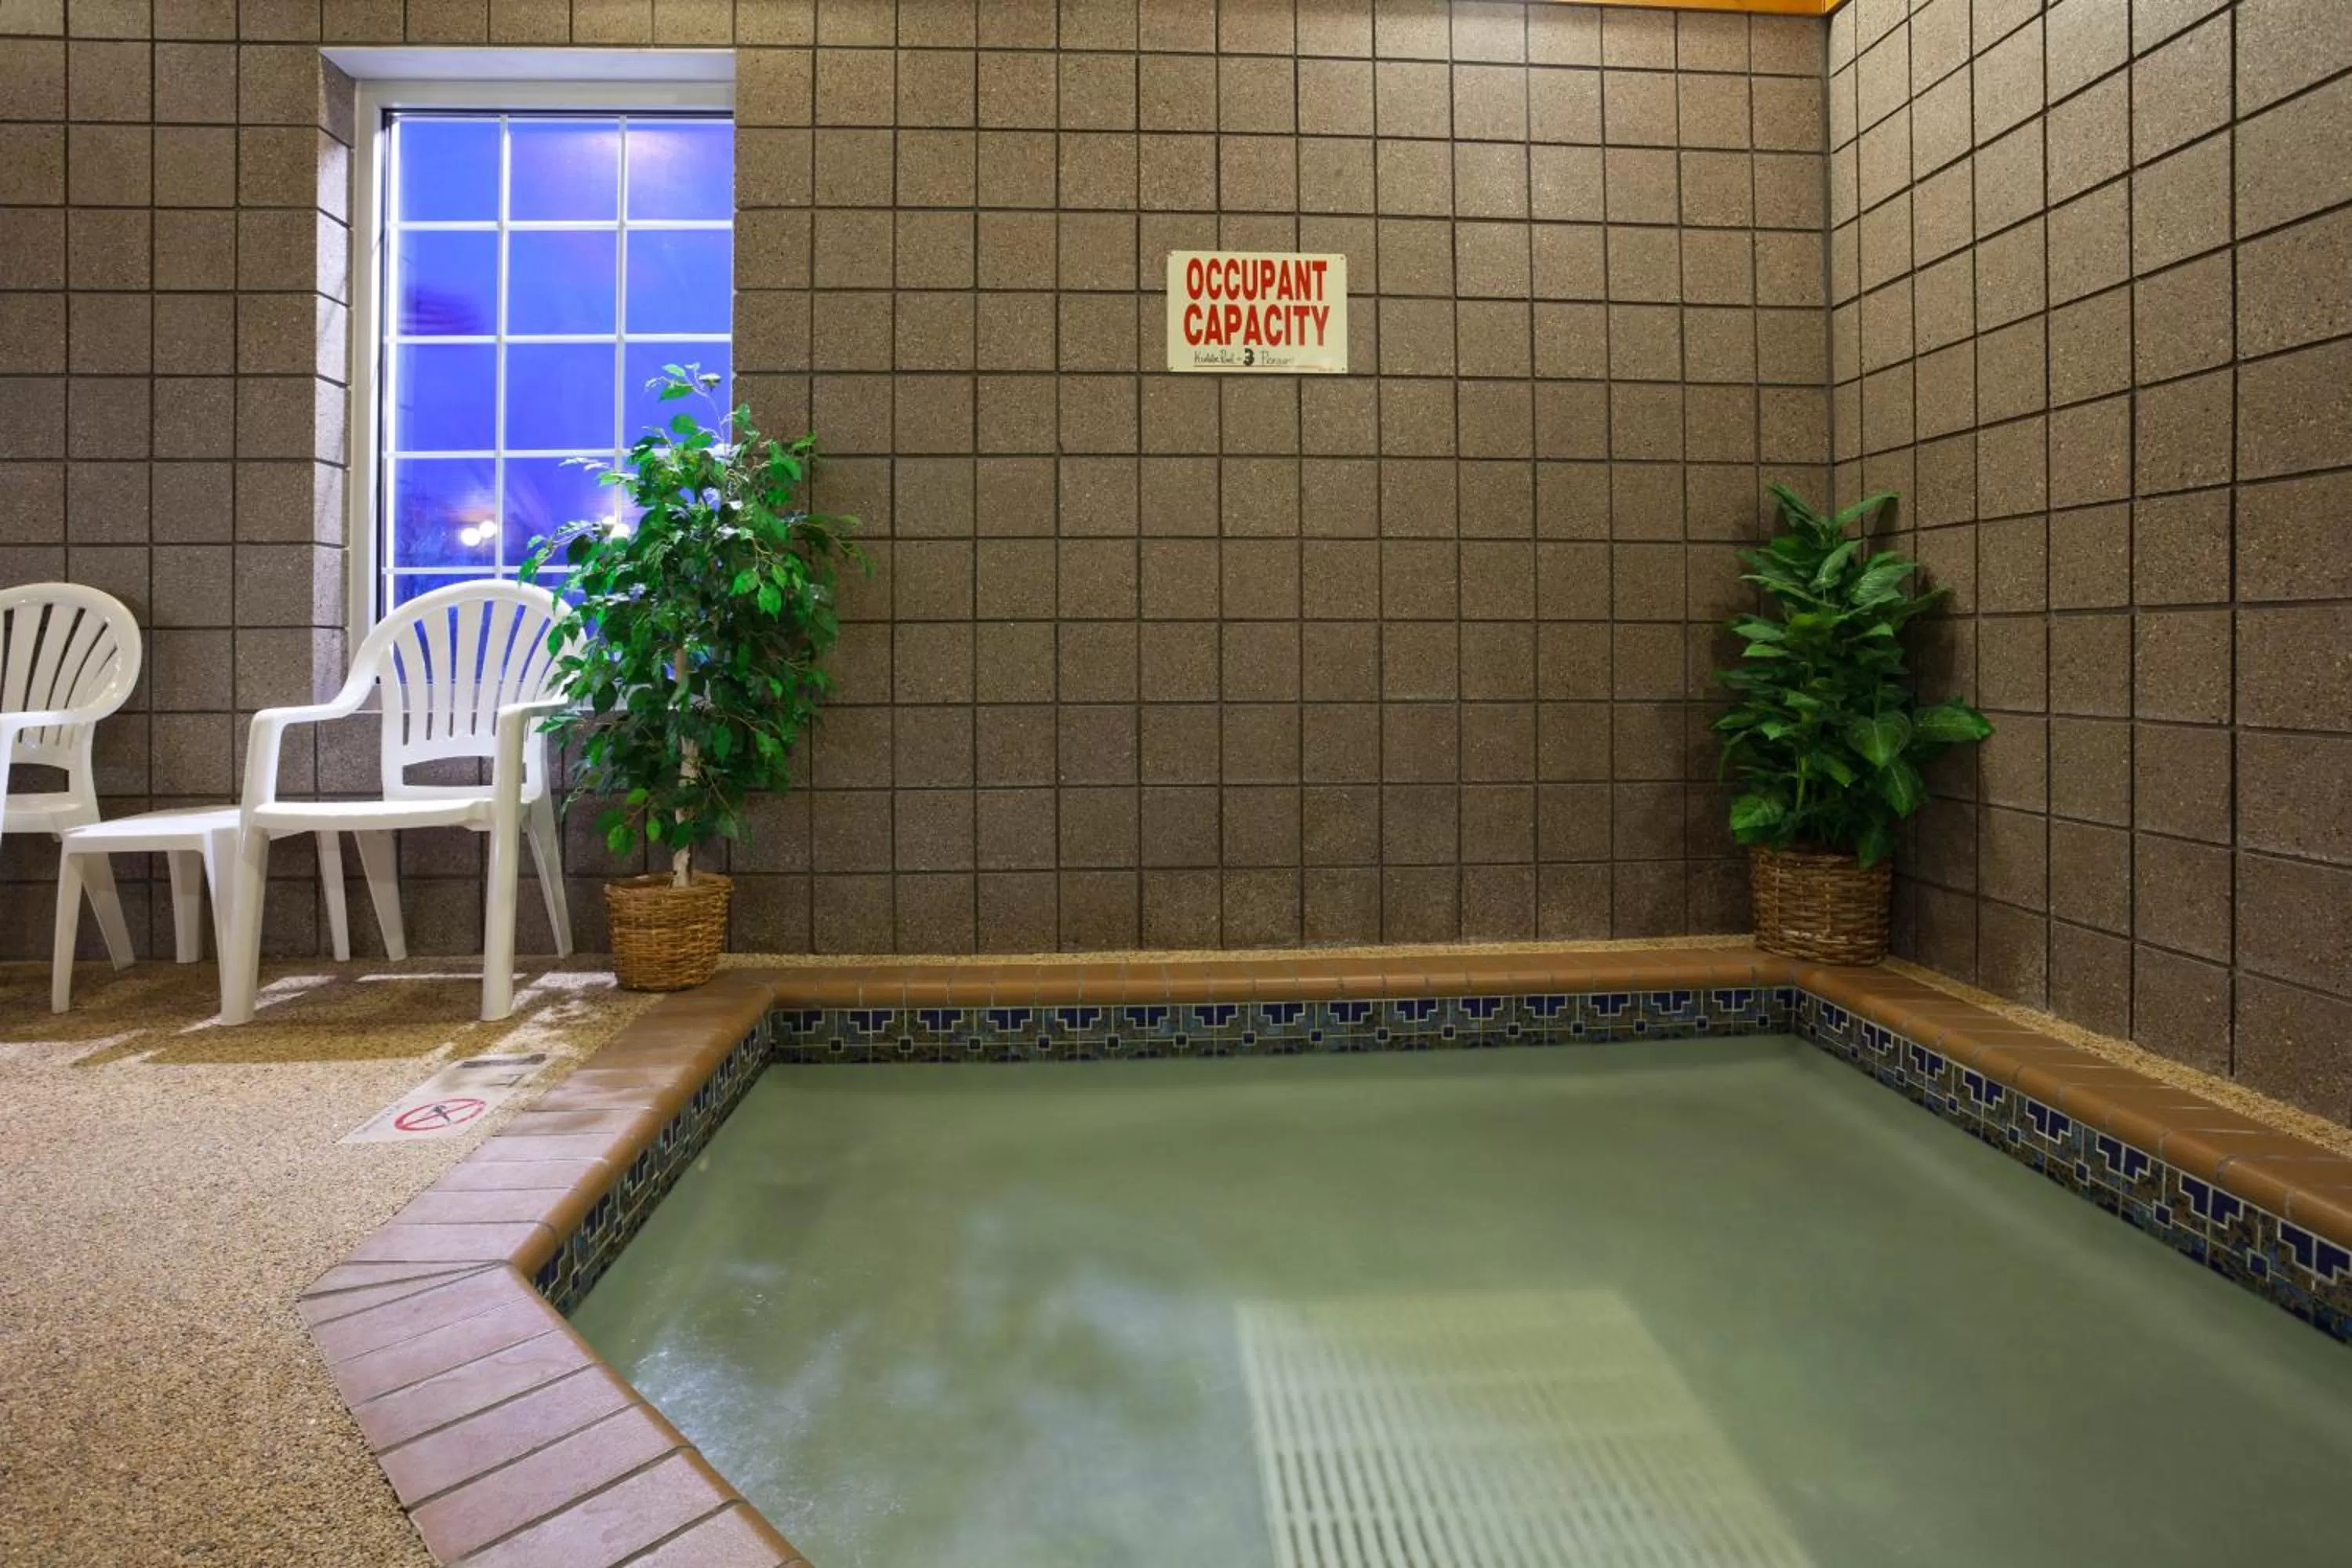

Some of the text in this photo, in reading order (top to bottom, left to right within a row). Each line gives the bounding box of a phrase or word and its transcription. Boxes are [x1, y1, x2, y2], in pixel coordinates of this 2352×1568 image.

[1186, 257, 1327, 302] OCCUPANT
[1183, 303, 1330, 347] CAPACITY
[1243, 347, 1255, 366] 3
